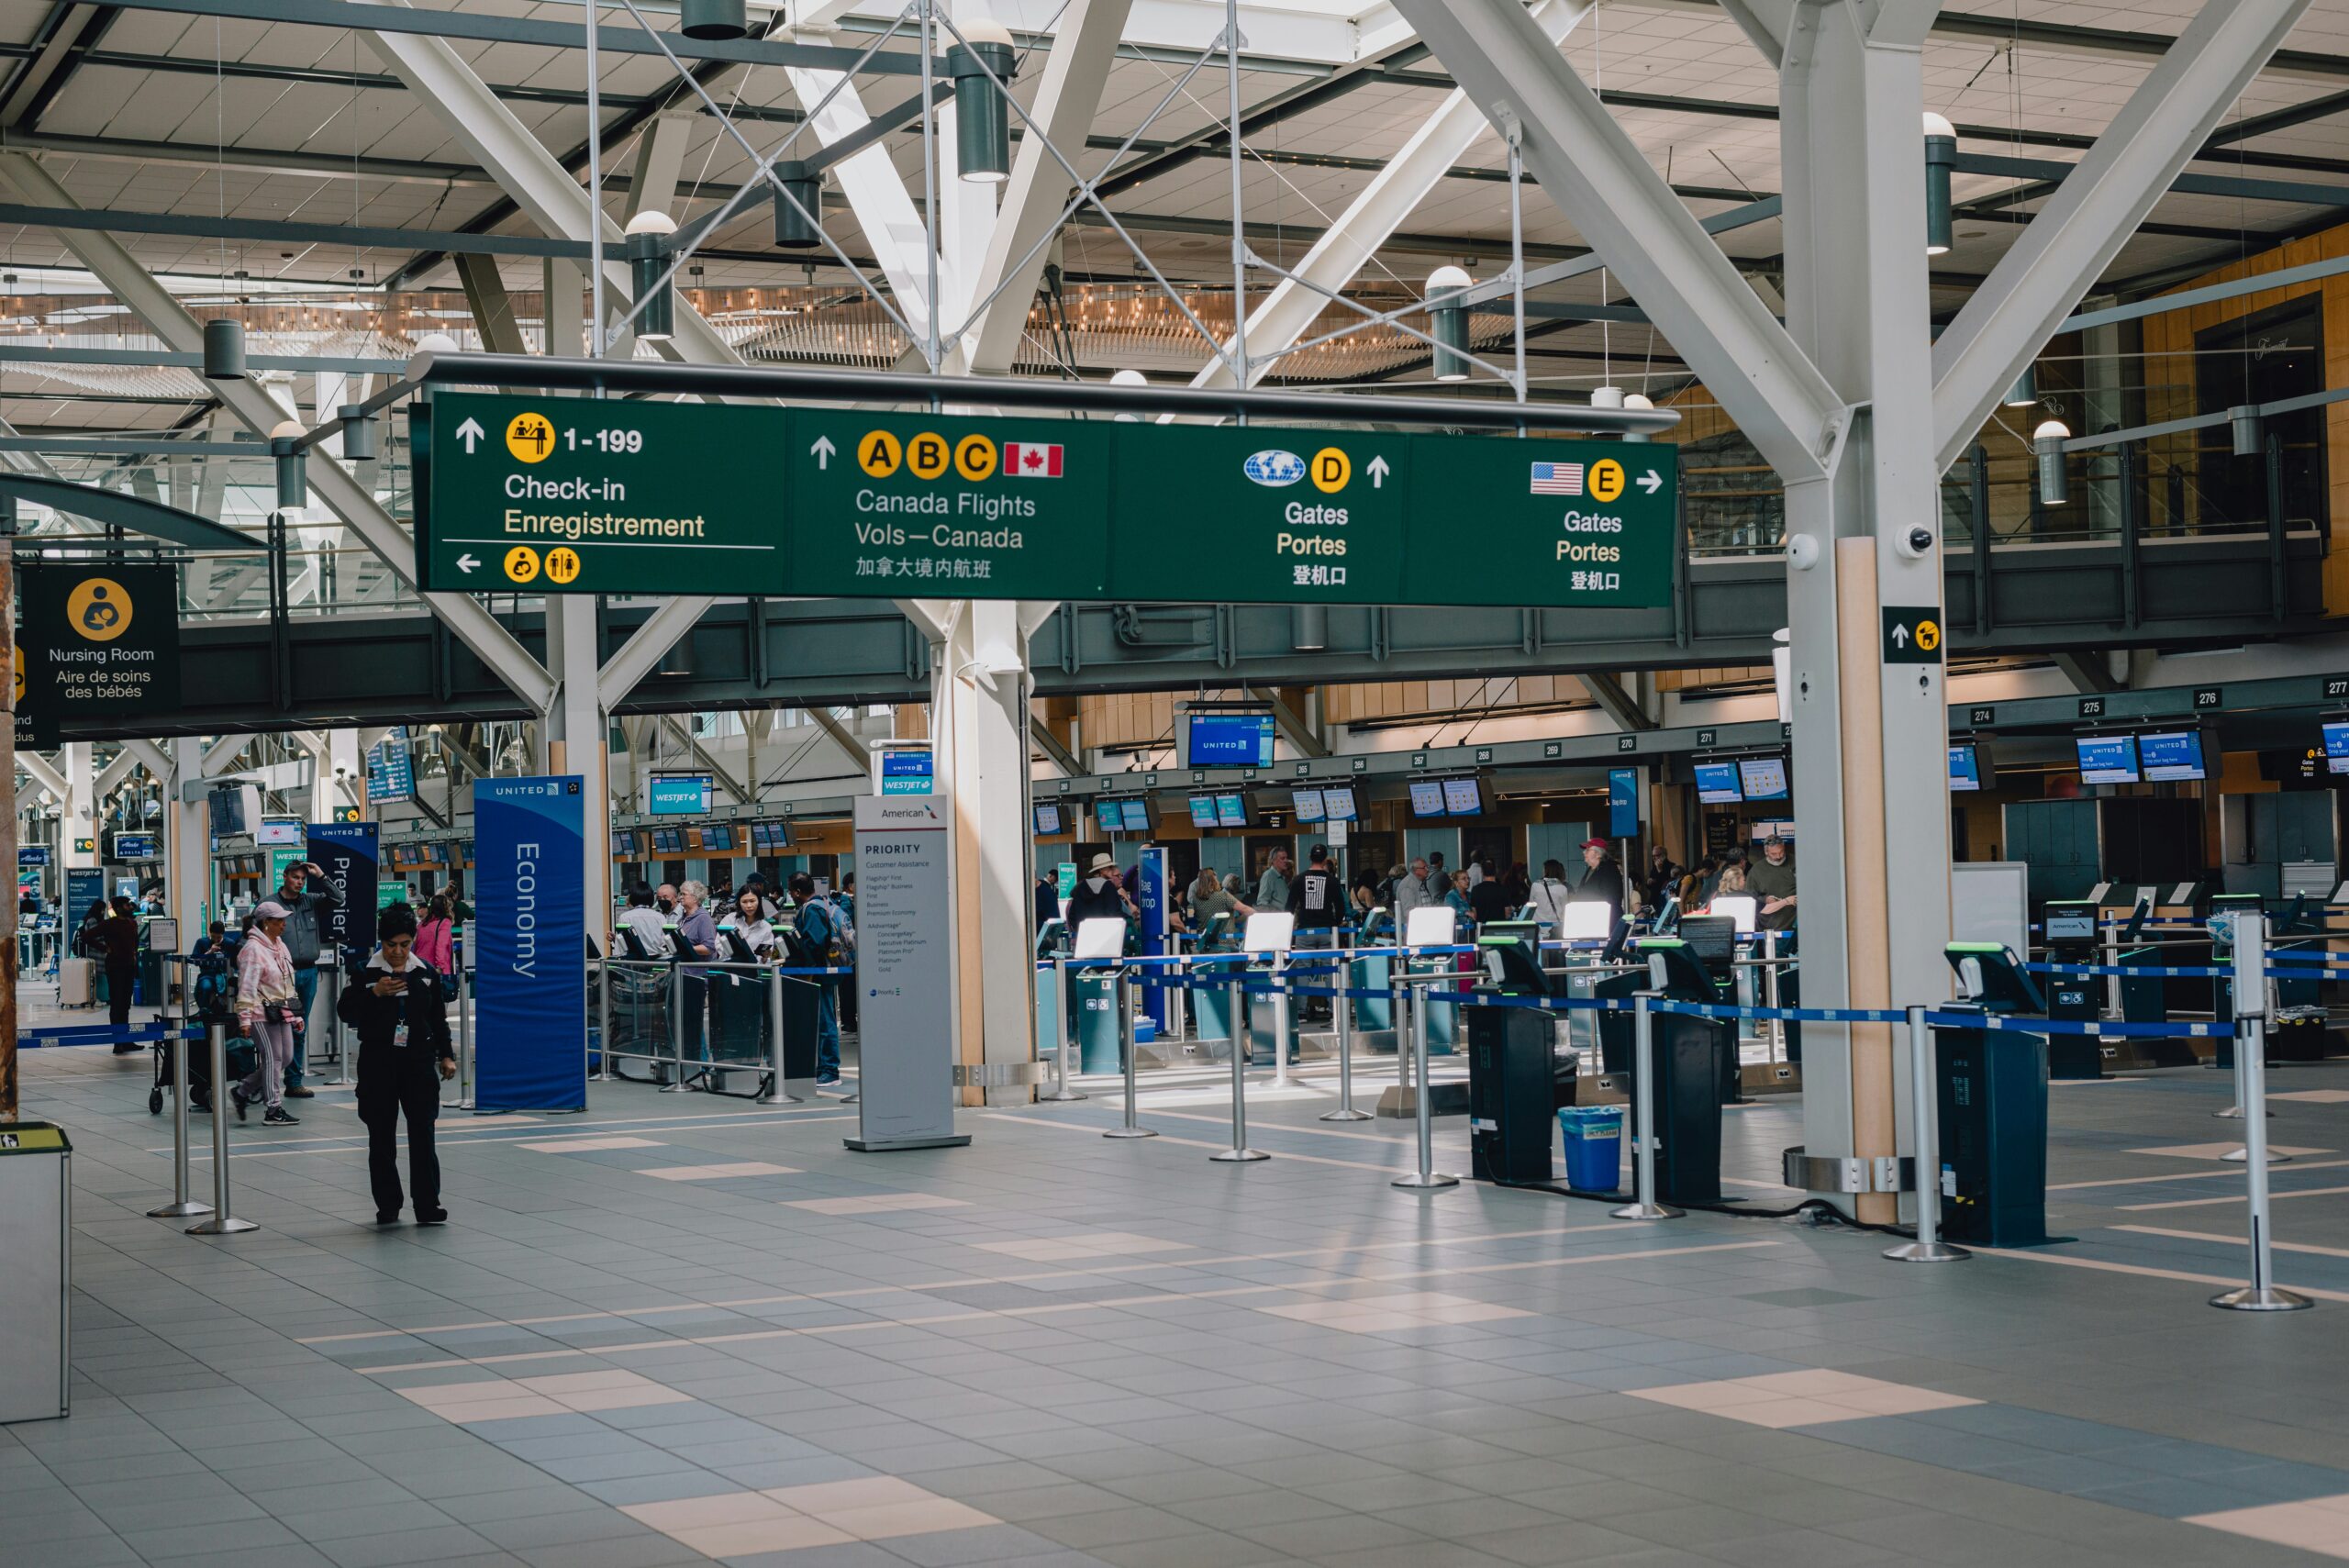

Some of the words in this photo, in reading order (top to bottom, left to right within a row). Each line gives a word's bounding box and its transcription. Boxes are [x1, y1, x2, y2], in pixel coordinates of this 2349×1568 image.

[563, 428, 642, 454] 1-199
[867, 439, 892, 468] A
[919, 441, 941, 470] B
[963, 443, 988, 473] C
[1323, 457, 1341, 483] D
[1598, 468, 1614, 493] E
[505, 474, 625, 502] Check-in
[856, 489, 949, 515] Canada
[958, 492, 1035, 521] Flights
[1285, 502, 1349, 526] Gates
[505, 510, 705, 539] Enregistrement
[1564, 511, 1622, 533] Gates
[1276, 533, 1347, 556] Portes
[1556, 540, 1620, 562] Portes
[856, 557, 991, 580] 加拿大境内航班
[1293, 565, 1347, 586] 登机口
[1571, 572, 1620, 591] 登机口
[50, 649, 106, 664] Nursing
[111, 649, 154, 661] Room
[56, 671, 85, 684] Aire
[90, 671, 108, 683] de
[113, 670, 150, 683] soins
[65, 685, 93, 698] des
[97, 685, 142, 698] bébés
[2329, 682, 2348, 694] 277
[2199, 693, 2216, 704] 276
[2084, 702, 2099, 713] 275
[1975, 711, 1989, 721] 274
[1701, 734, 1711, 742] 271
[1546, 746, 1558, 755] 269
[1621, 740, 1633, 749] 270
[1414, 756, 1424, 765] 267
[1478, 751, 1489, 761] 268
[1297, 765, 1308, 773] 265
[1354, 761, 1364, 769] 266
[1245, 769, 1254, 777] 264
[495, 786, 544, 796] UNITED
[885, 781, 921, 791] WESTJET
[655, 793, 689, 804] WESTJET
[882, 809, 924, 818] American
[865, 844, 920, 855] PRIORITY
[19, 854, 43, 862] Alaska
[513, 842, 540, 979] Economy
